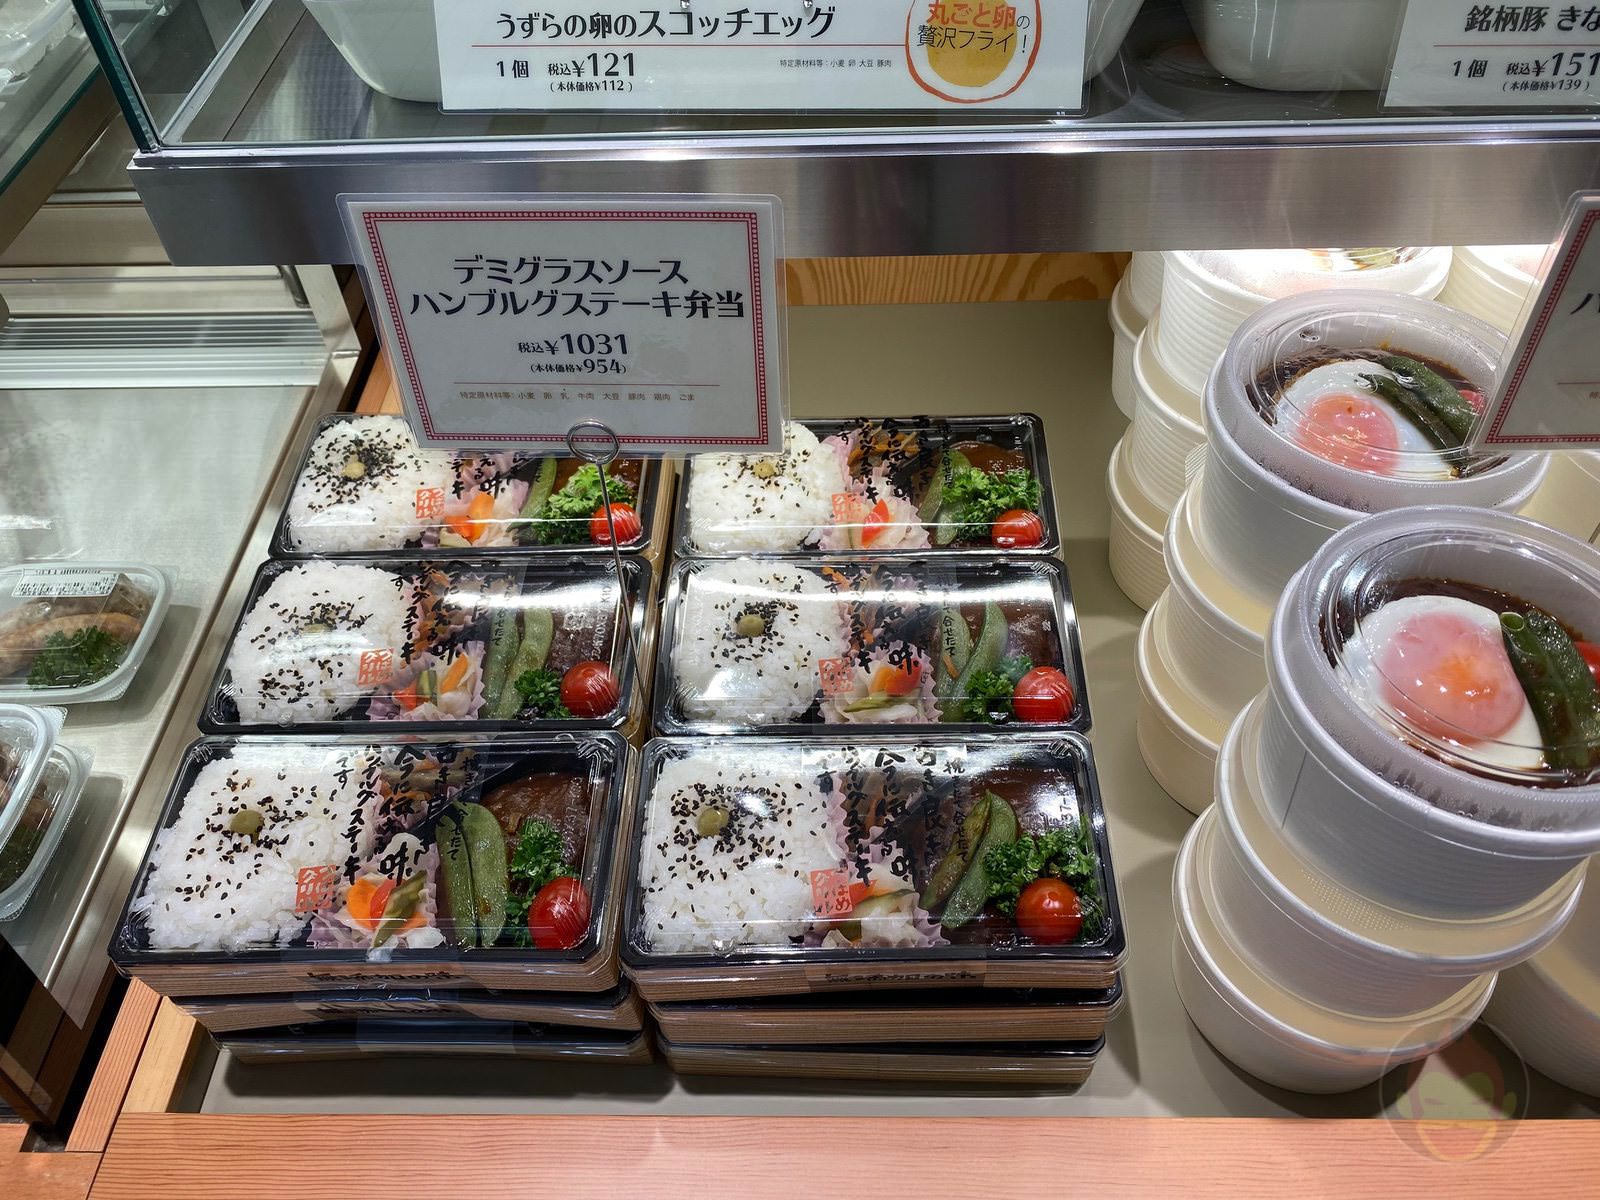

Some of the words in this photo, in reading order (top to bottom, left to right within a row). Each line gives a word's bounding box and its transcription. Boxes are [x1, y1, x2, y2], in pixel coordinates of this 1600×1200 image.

[497, 7, 836, 39] うずらの卵のスコッチエッグ
[926, 0, 1031, 30] 丸ごと卵の
[1464, 5, 1550, 32] 銘柄豚
[453, 253, 689, 285] デミグラスソース
[410, 289, 745, 319] ハンブルグステーキ弁当
